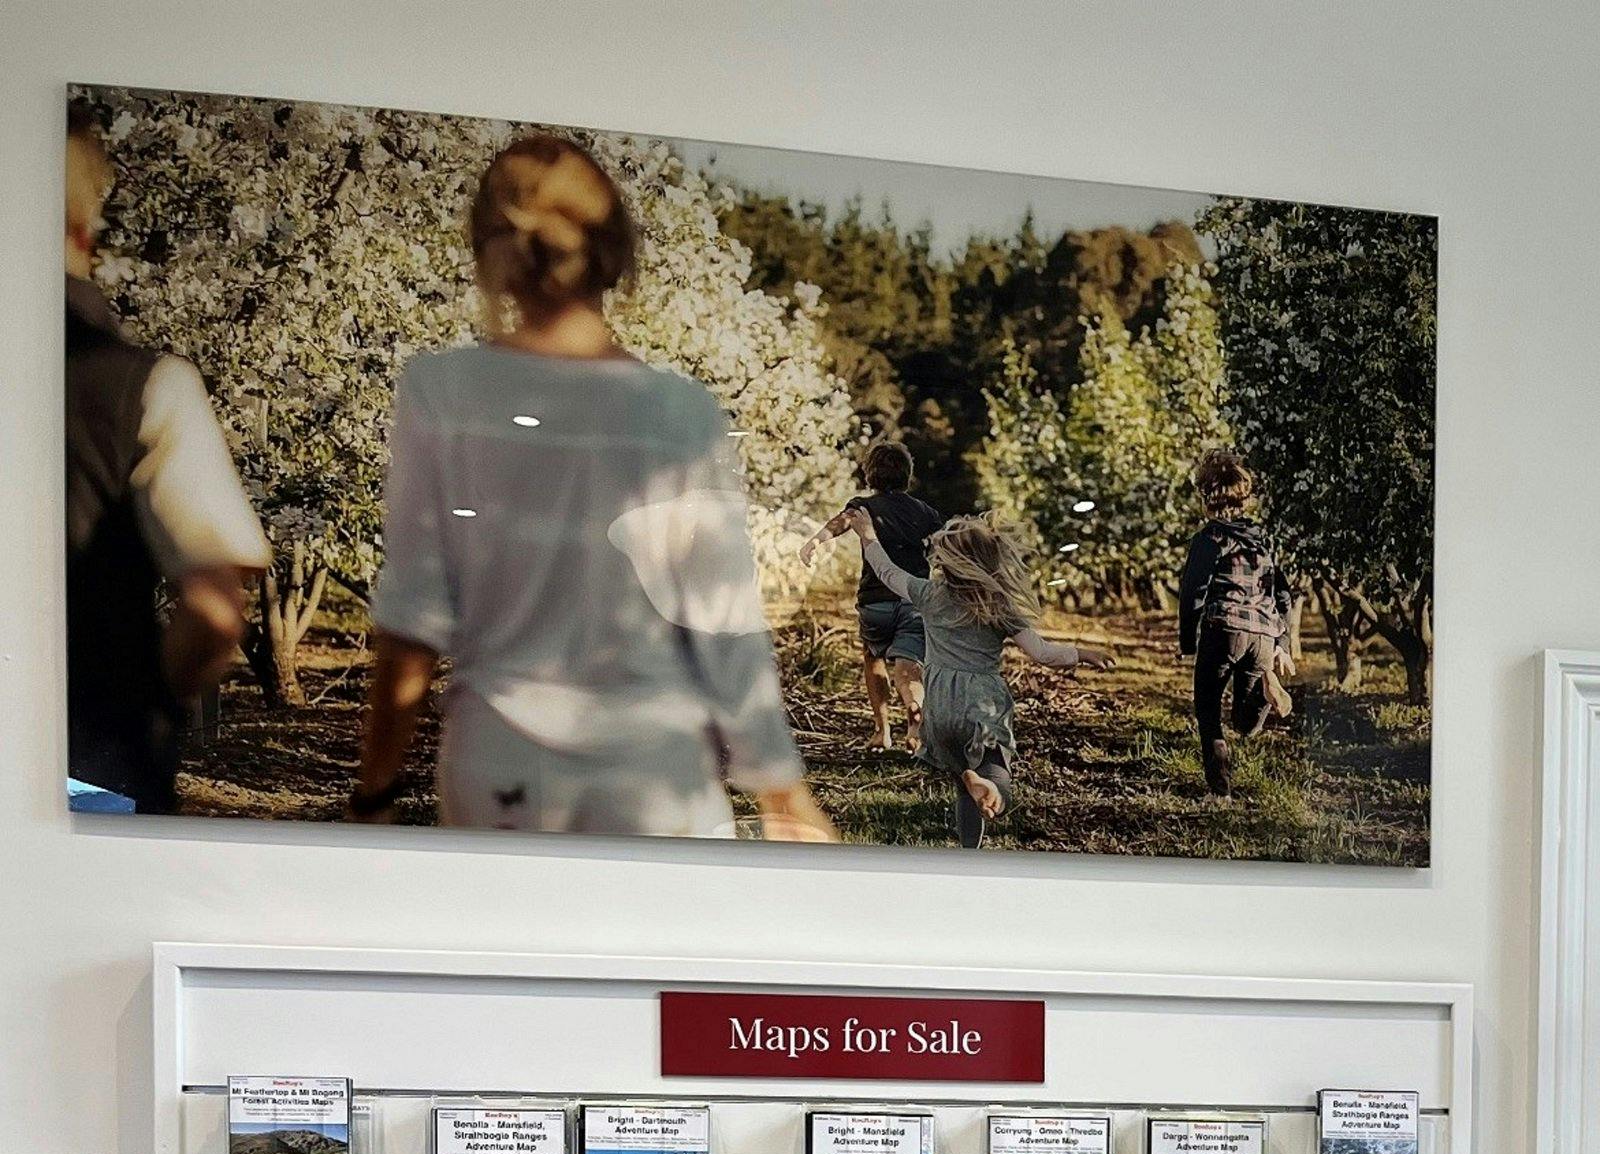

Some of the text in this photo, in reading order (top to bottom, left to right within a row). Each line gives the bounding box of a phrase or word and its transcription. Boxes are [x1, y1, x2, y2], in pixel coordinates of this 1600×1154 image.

[729, 1017, 982, 1058] Maps for Sale
[244, 1088, 288, 1096] Feathertop
[608, 1116, 686, 1125] Bright Dartmouth
[1379, 1112, 1409, 1120] Ranges
[498, 1121, 545, 1130] Mansfield,
[828, 1127, 905, 1136] Bright Mansfield
[995, 1127, 1032, 1136] Corryong
[455, 1132, 547, 1141] Strathbogie Ranges
[1163, 1132, 1188, 1141] Dargo
[833, 1138, 899, 1147] Adventure Map
[517, 1143, 536, 1152] Map
[1176, 1143, 1238, 1152] Adventure Map
